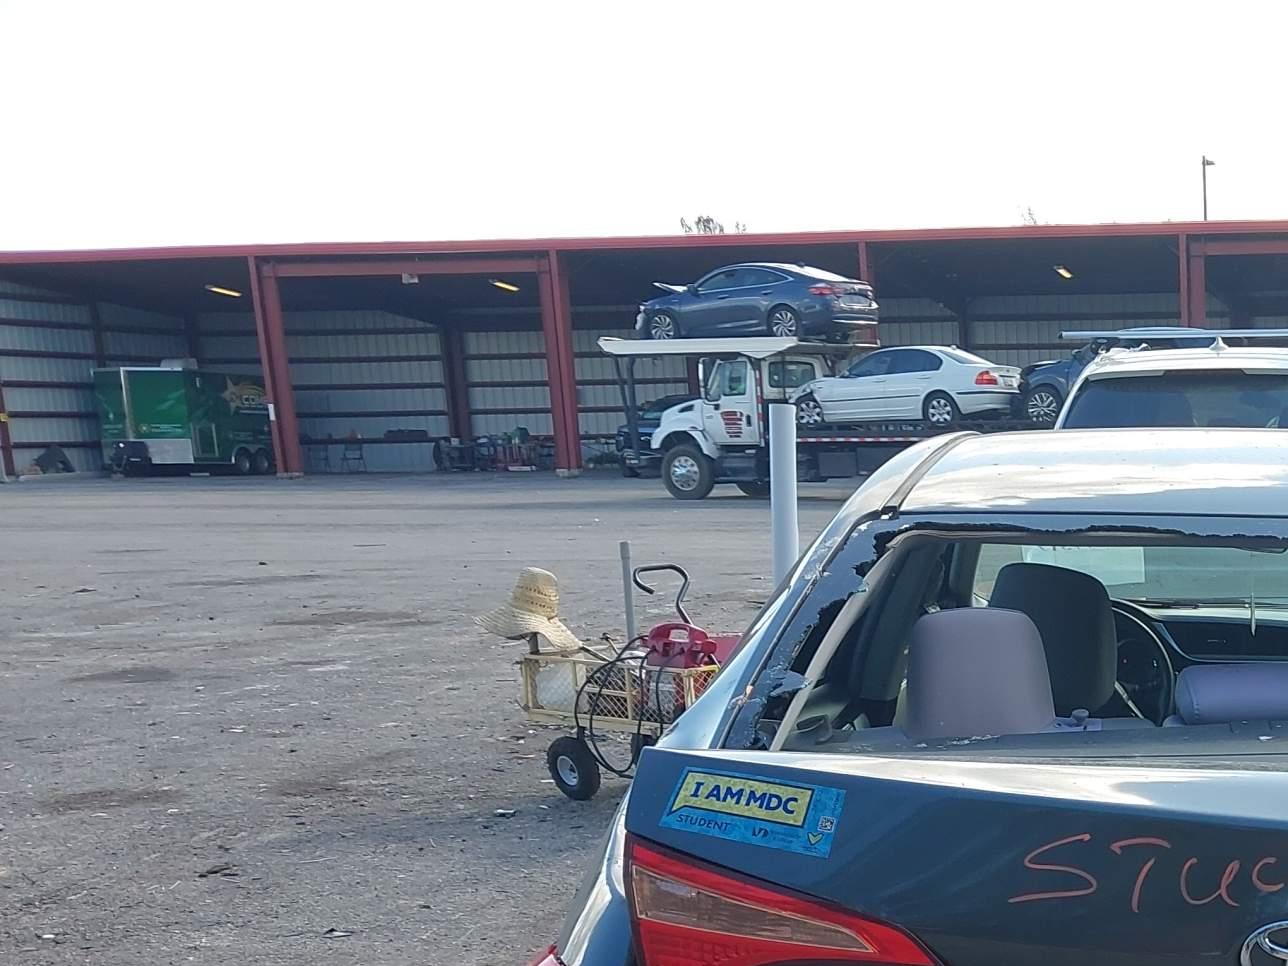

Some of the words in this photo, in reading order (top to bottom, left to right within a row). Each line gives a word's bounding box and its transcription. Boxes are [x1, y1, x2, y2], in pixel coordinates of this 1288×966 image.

[690, 781, 704, 799] I
[705, 784, 743, 805] AM
[745, 791, 799, 815] MDC
[676, 813, 731, 831] STUDENT
